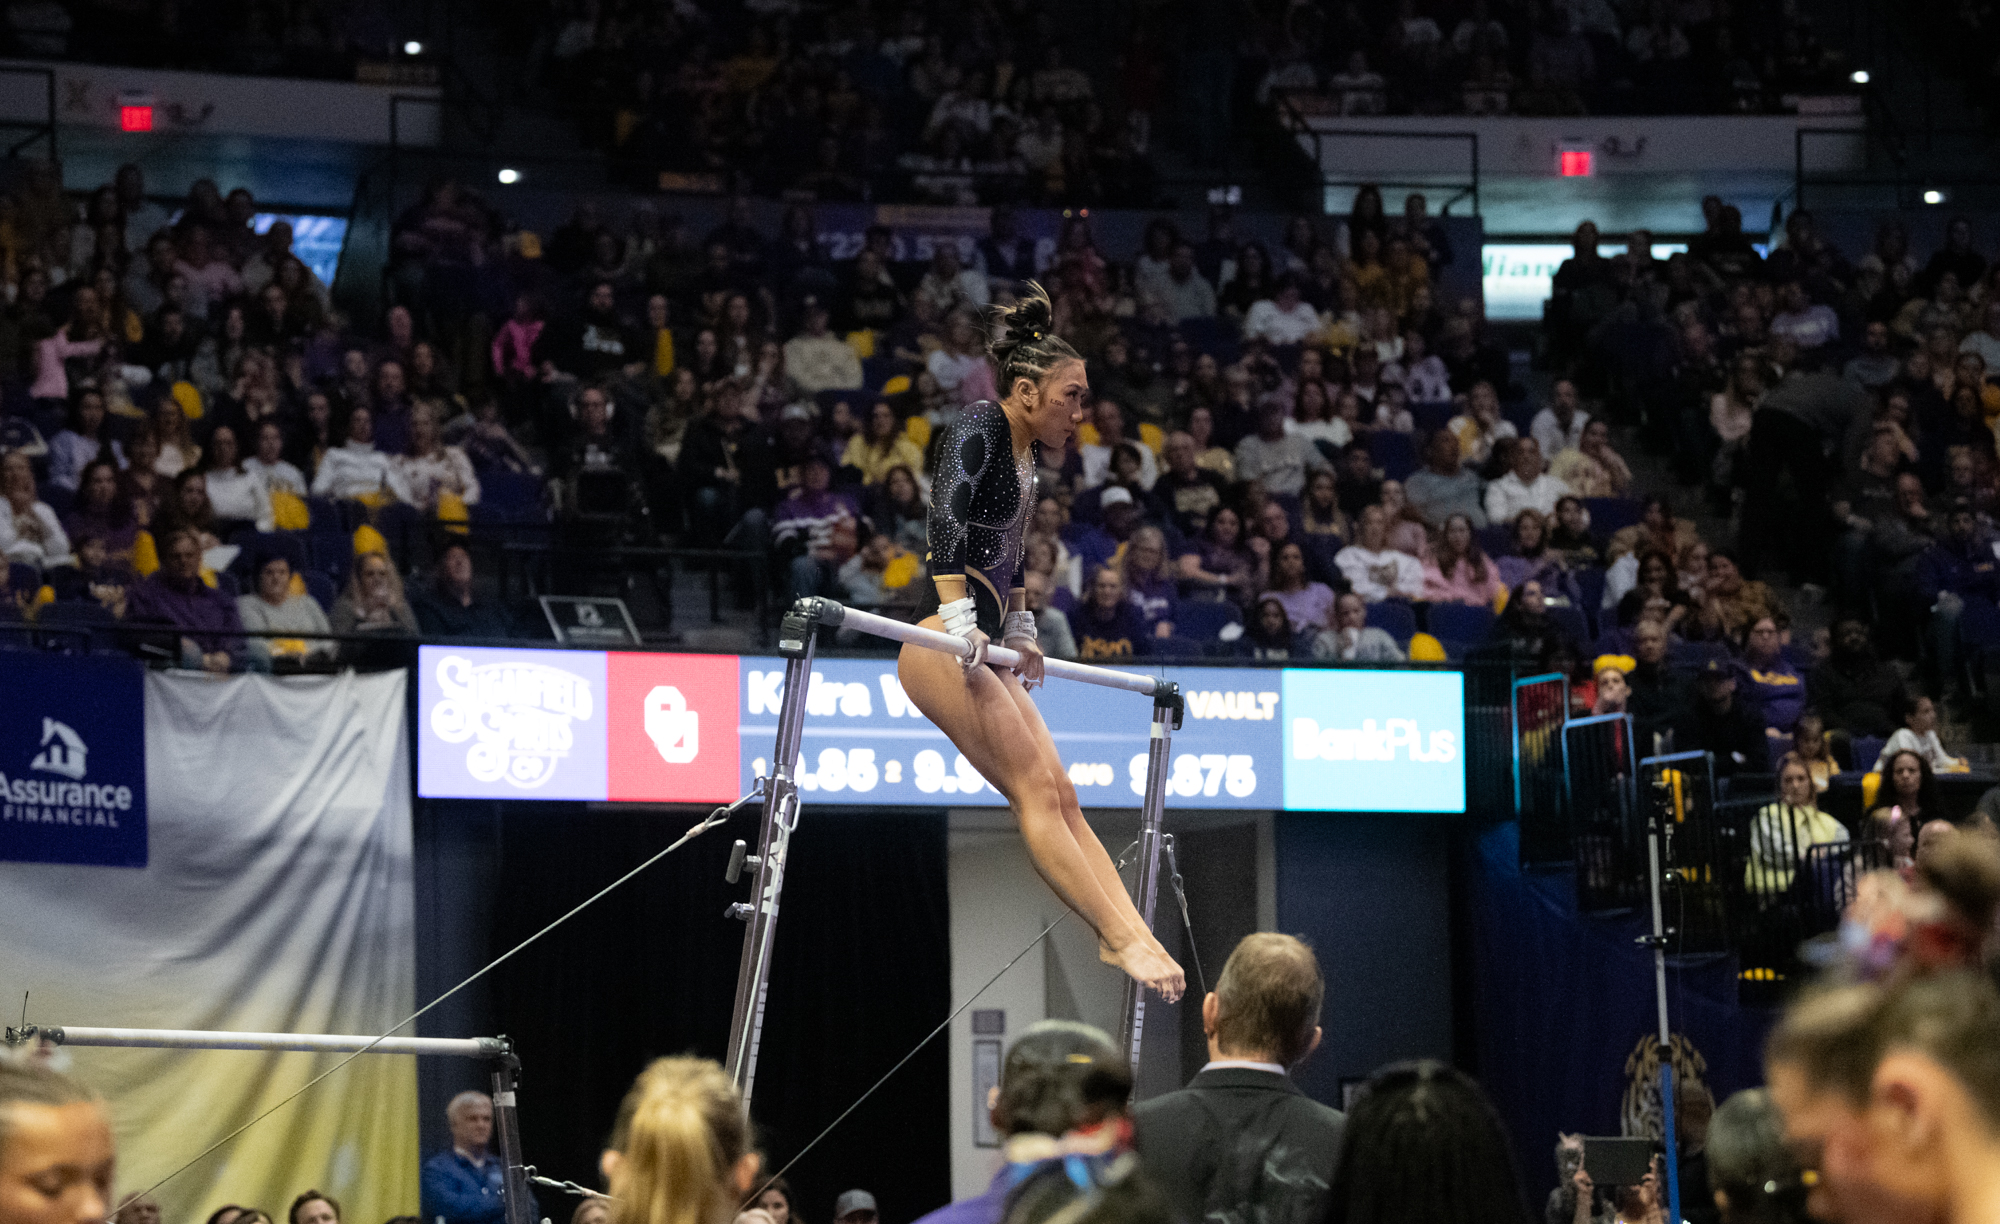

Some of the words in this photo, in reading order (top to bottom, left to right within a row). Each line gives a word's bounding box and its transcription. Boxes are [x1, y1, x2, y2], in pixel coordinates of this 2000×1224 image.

[1050, 398, 1065, 407] LSU
[1186, 690, 1279, 720] VAULT
[1292, 717, 1457, 763] BankPlus
[885, 760, 902, 783] 2
[913, 749, 1001, 793] 9.9
[0, 771, 132, 811] Assurance
[3, 804, 119, 828] FINANCIAL
